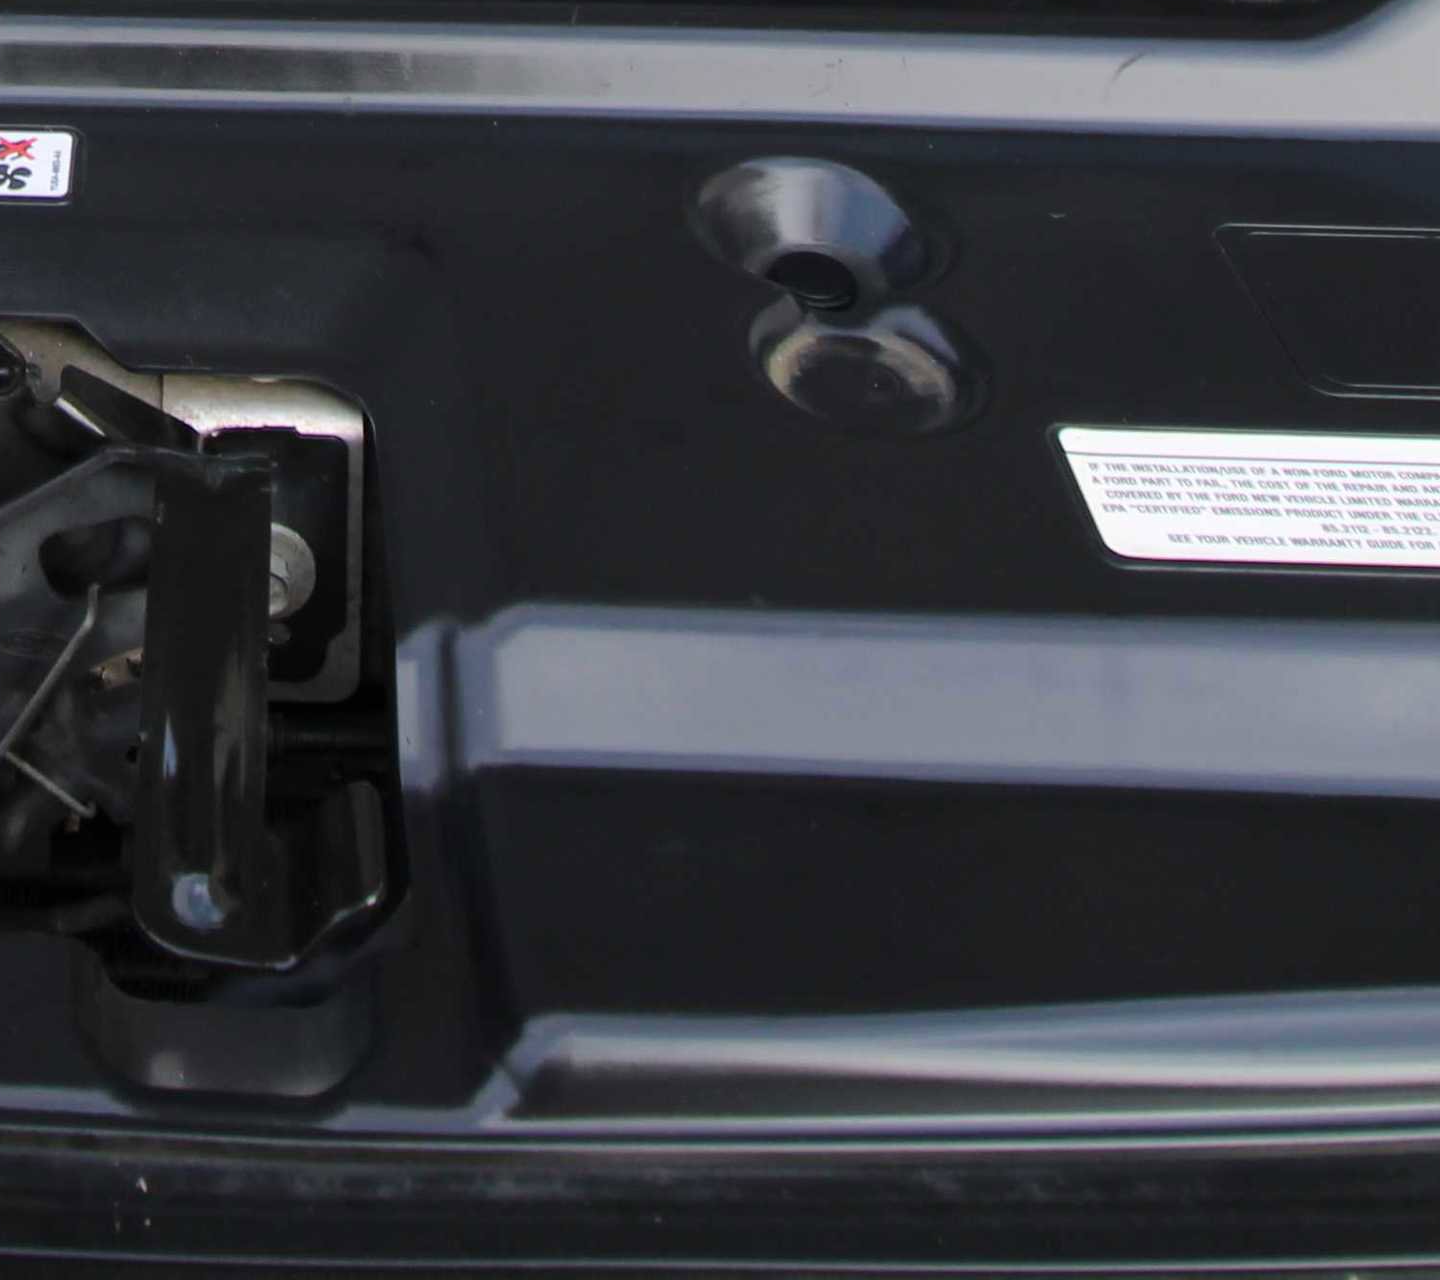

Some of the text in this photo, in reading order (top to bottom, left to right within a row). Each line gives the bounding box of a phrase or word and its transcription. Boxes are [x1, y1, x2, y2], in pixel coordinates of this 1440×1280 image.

[1105, 463, 1127, 472] THE
[1350, 470, 1396, 479] MOTOR
[1103, 477, 1137, 485] FORD
[1141, 478, 1172, 486] PART
[1232, 480, 1255, 488] THE
[1258, 480, 1291, 490] COST
[1315, 482, 1339, 491] THE
[1392, 485, 1418, 493] AND
[1105, 490, 1162, 500] COVERED
[1188, 492, 1210, 501] THE
[1214, 493, 1248, 502] FORD
[1285, 495, 1337, 504] VEHICLE
[1340, 497, 1392, 505] LIMITED
[1212, 507, 1283, 517] EMISSIONS
[1284, 509, 1344, 518] PRODUCT
[1348, 511, 1392, 520] UNDER
[1396, 512, 1420, 520] THE
[1234, 536, 1286, 546] VEHICLE
[1289, 538, 1361, 548] WARRANTY
